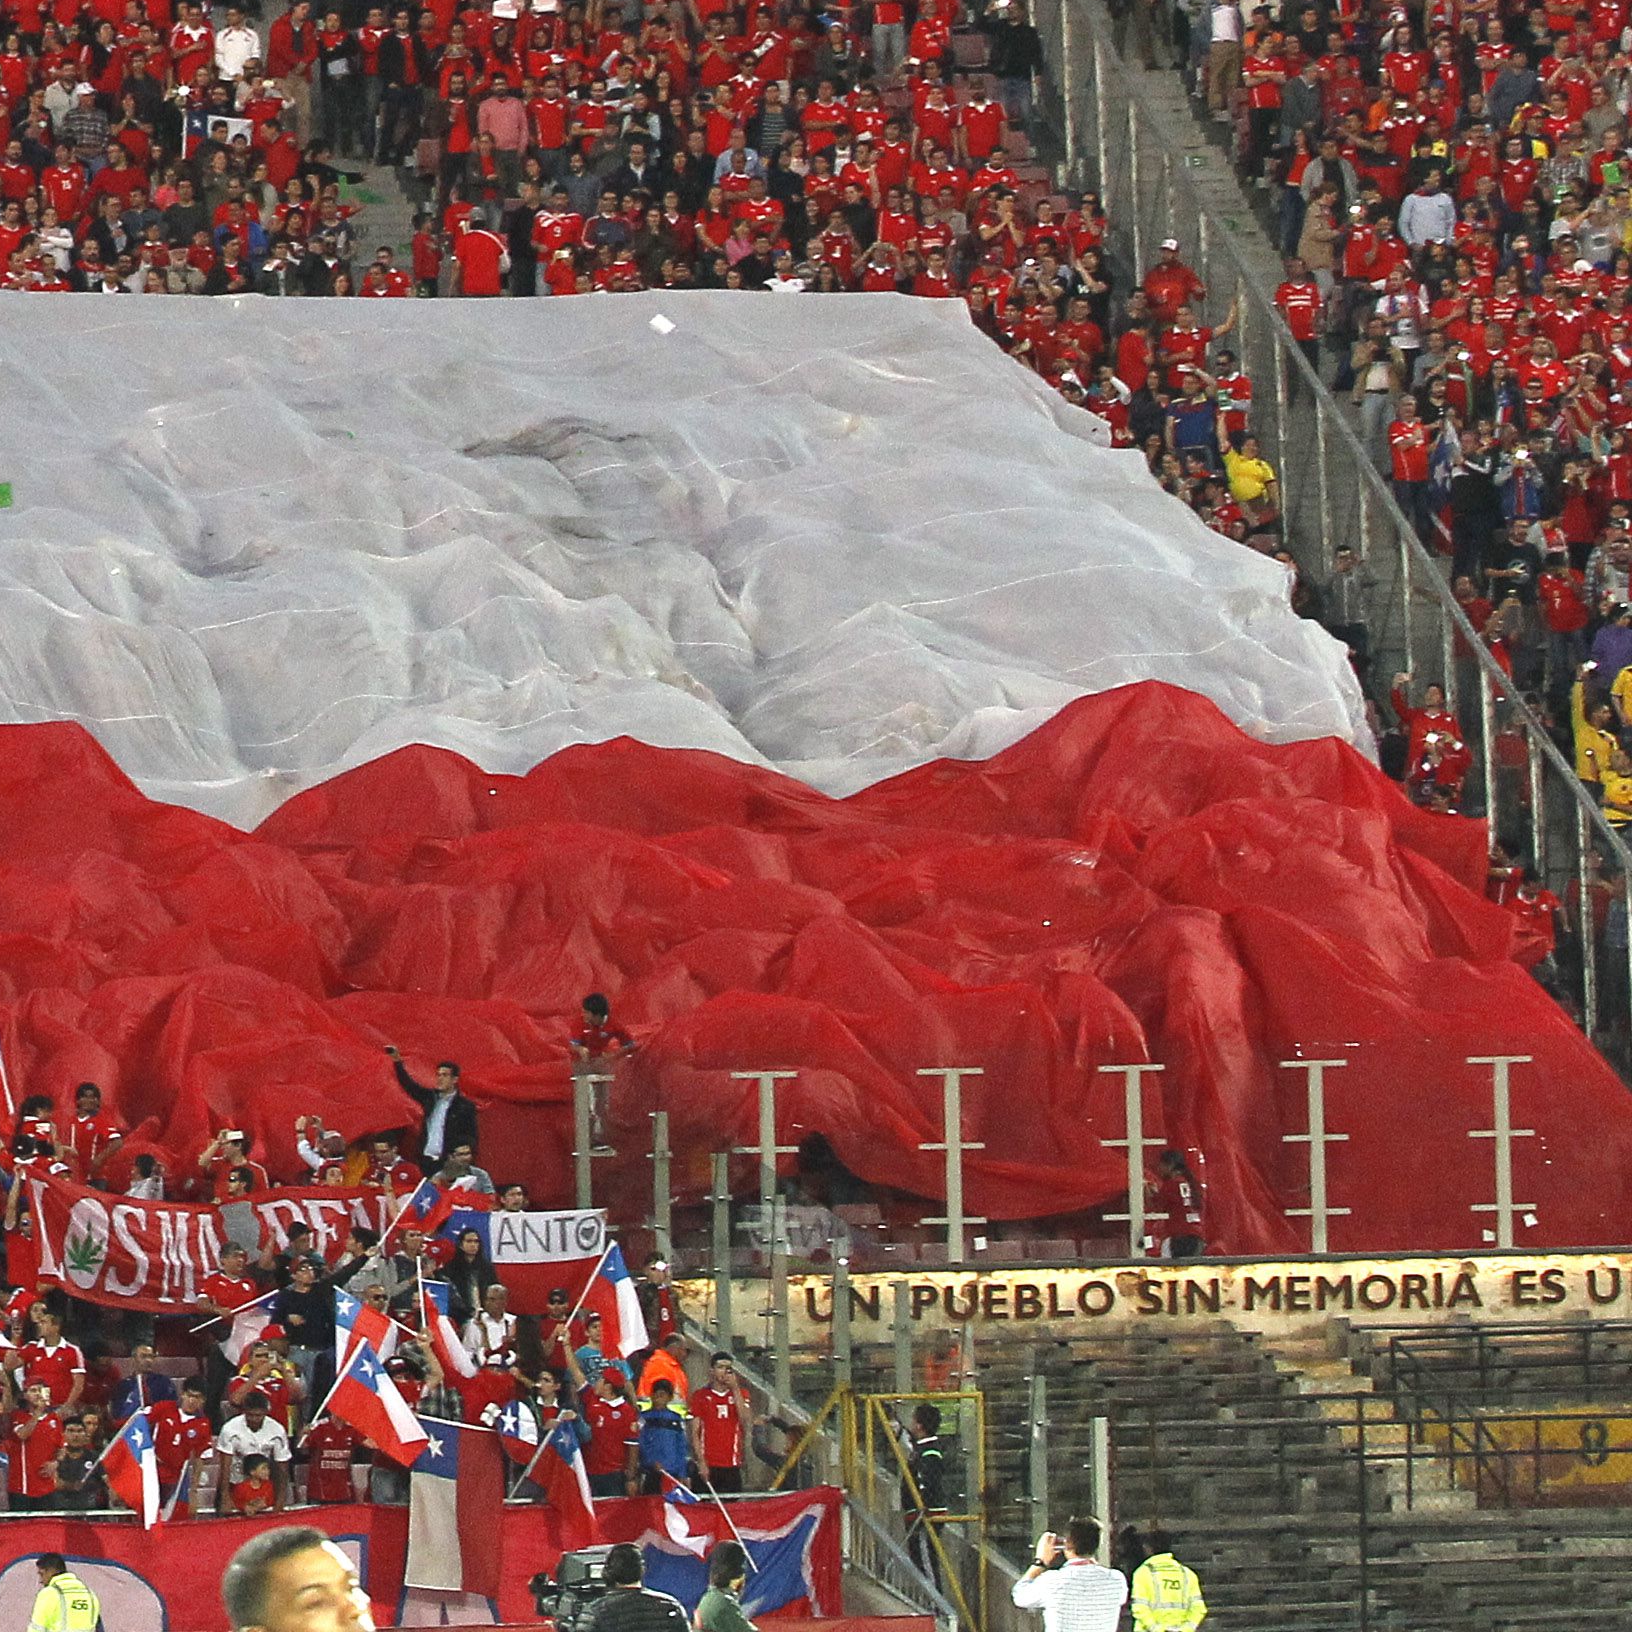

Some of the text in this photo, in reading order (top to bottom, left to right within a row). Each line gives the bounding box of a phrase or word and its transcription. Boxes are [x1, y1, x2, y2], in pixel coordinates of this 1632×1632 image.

[496, 1217, 603, 1255] ANTO
[804, 1267, 1632, 1322] UN PUEBLO SIN MEMORIA ES U
